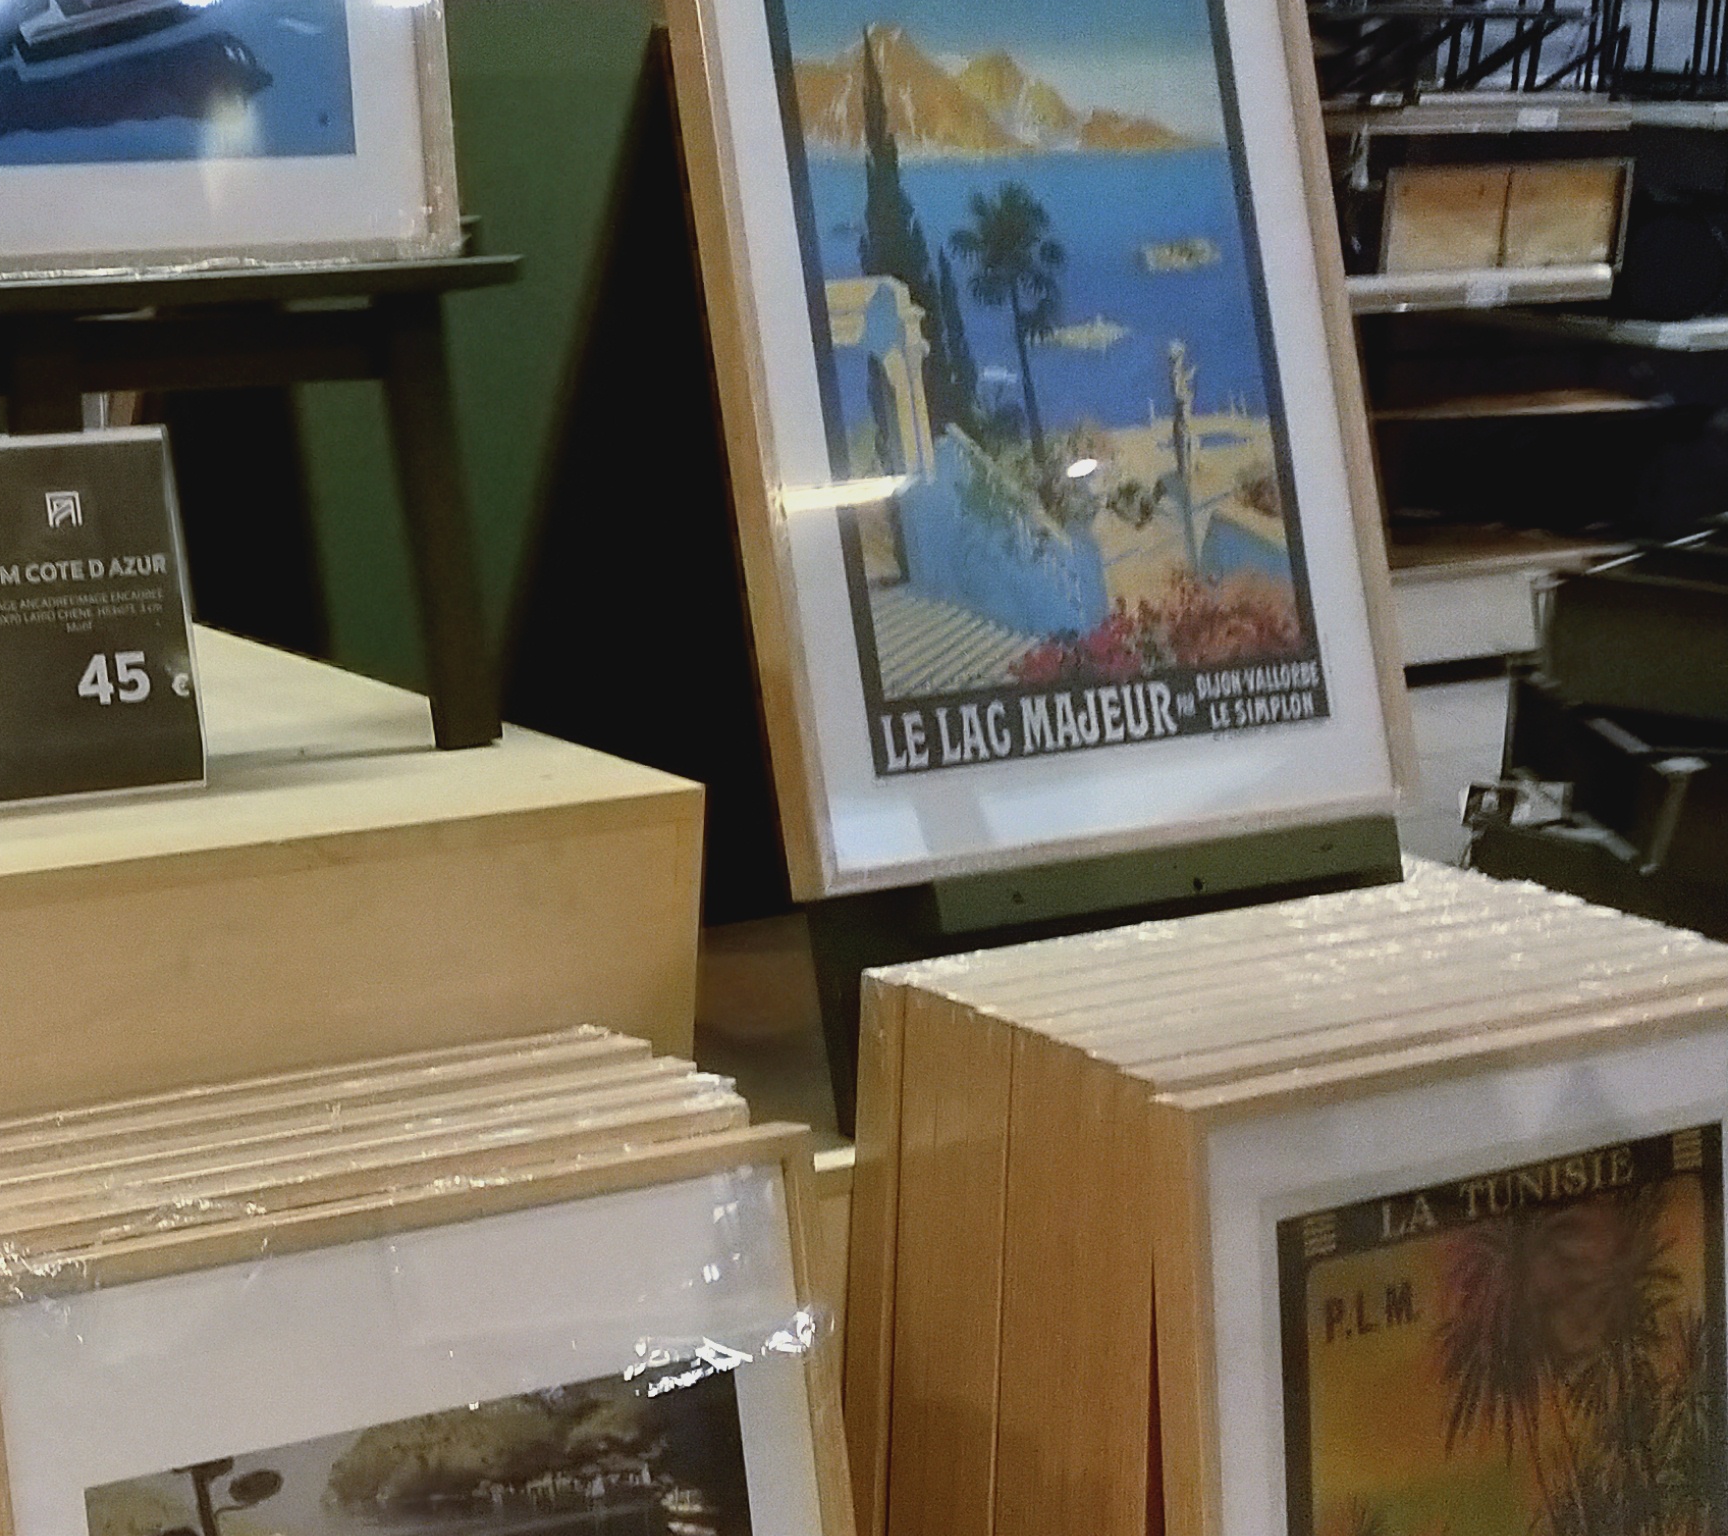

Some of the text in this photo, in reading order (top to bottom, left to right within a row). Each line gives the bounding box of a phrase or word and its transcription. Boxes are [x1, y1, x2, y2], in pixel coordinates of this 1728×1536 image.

[24, 559, 86, 585] COTE
[88, 558, 106, 580] D
[108, 553, 168, 579] AZUR
[77, 650, 191, 706] 45 €
[880, 711, 930, 771] LE
[935, 700, 1012, 764] LAC
[1018, 680, 1179, 755] MAJEUR
[1209, 690, 1315, 730] LE SIMPLON
[1381, 1146, 1634, 1239] LA TUNISIE
